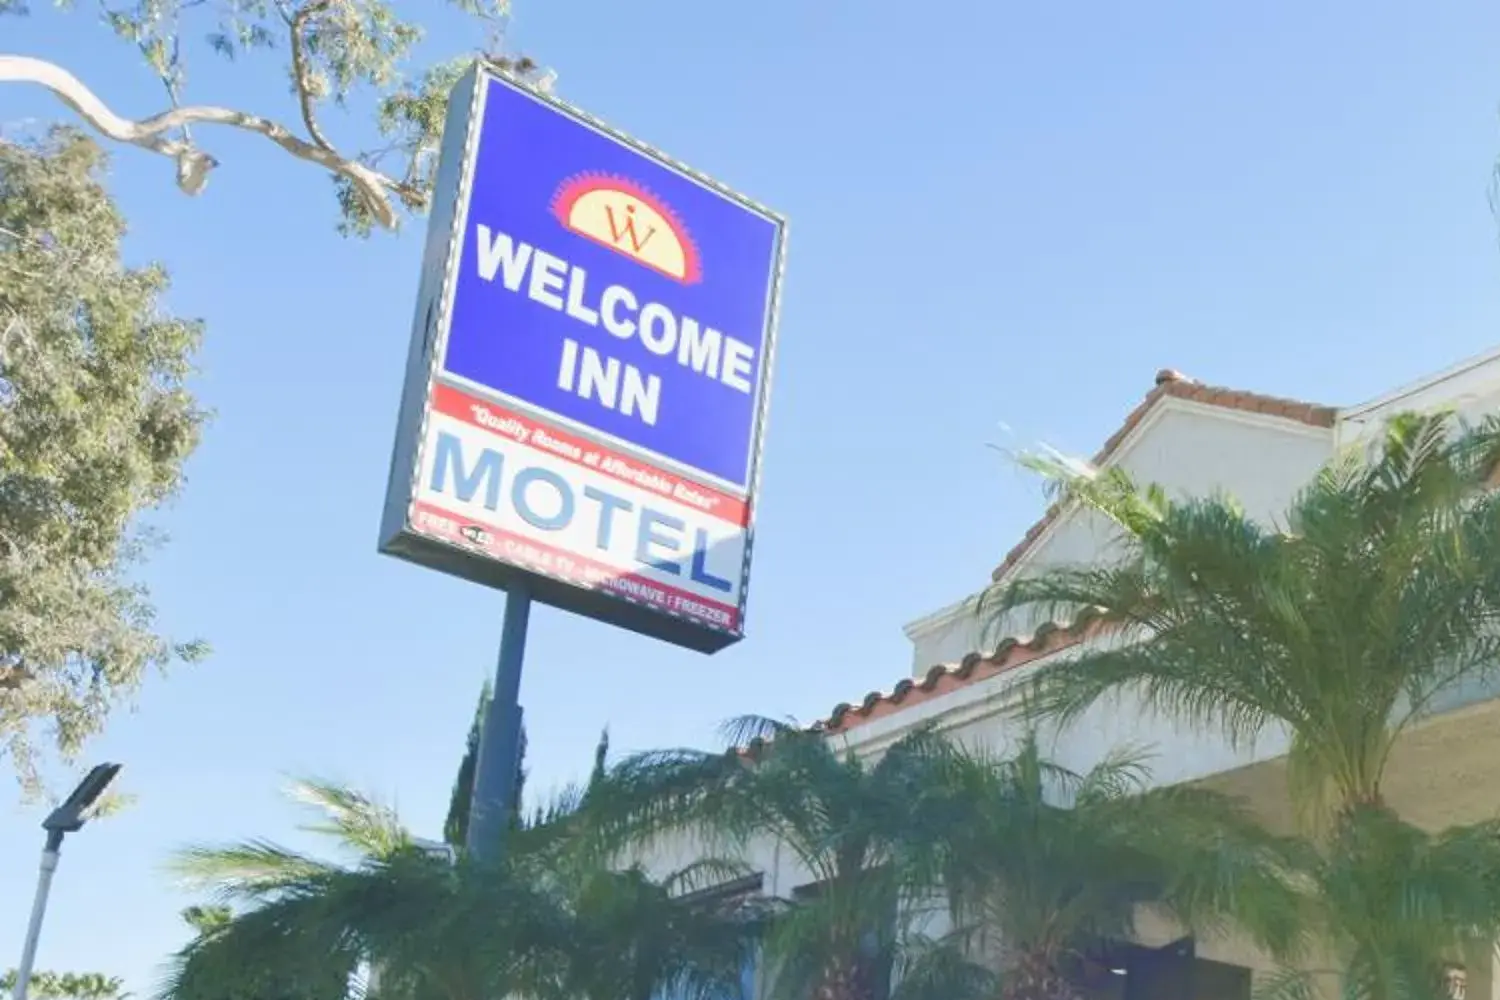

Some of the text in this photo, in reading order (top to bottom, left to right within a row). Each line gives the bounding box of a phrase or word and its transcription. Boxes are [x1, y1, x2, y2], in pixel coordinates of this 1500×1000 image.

[475, 223, 755, 394] WELCOME
[557, 338, 661, 427] INN
[531, 428, 582, 461] Rooms
[583, 450, 599, 466] at
[430, 429, 733, 593] MOTEL
